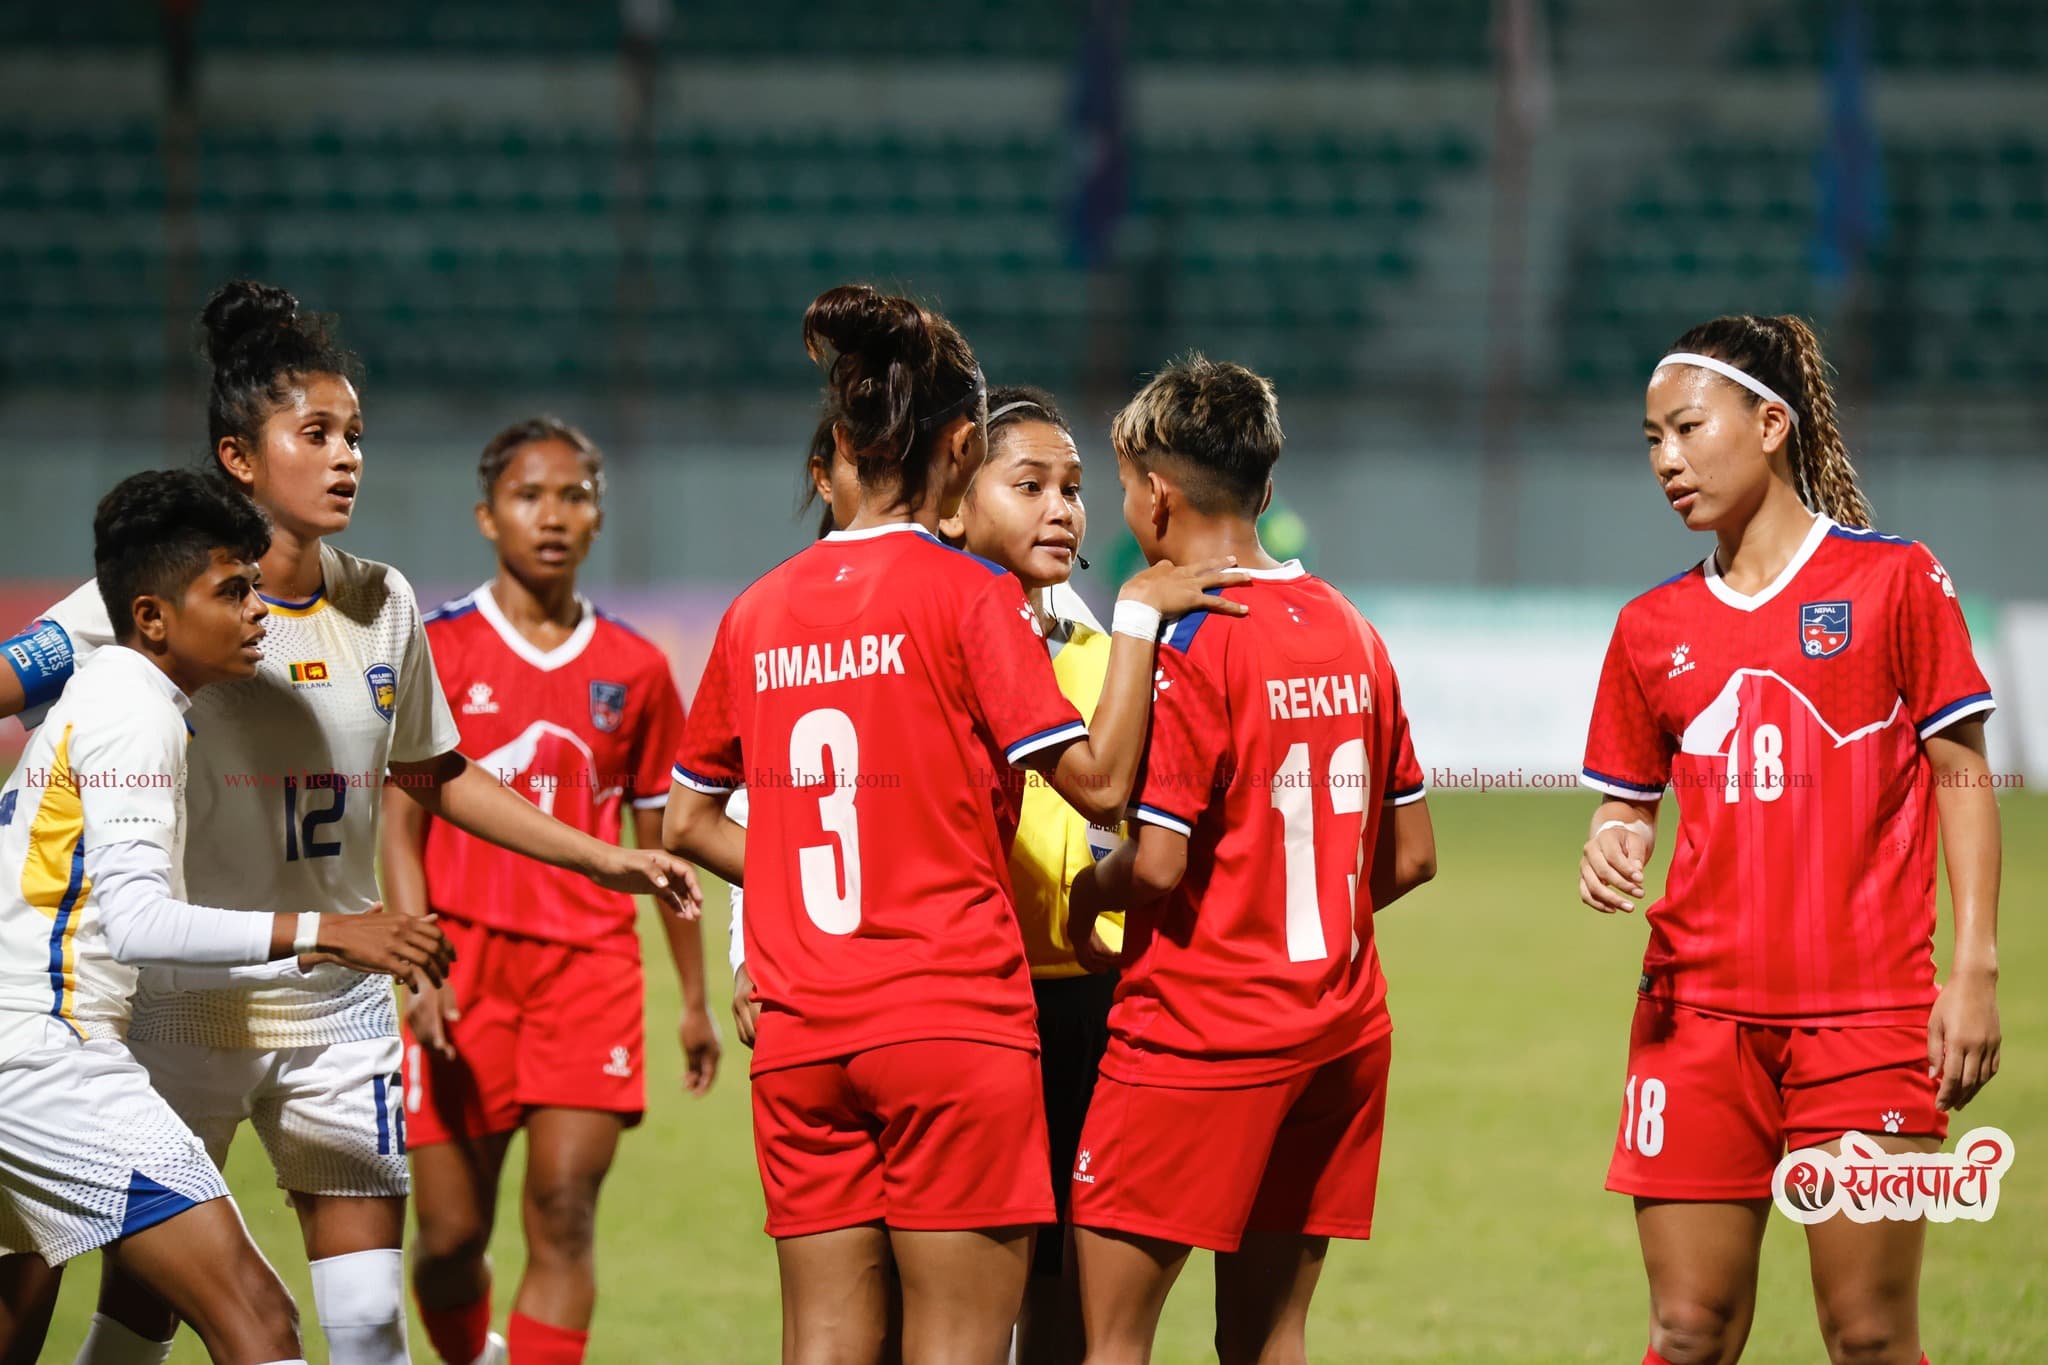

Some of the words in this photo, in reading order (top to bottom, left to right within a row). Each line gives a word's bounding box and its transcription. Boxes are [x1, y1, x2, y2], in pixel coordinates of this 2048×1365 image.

[12, 647, 28, 666] FIFA
[31, 650, 53, 678] World
[32, 631, 65, 671] UNITES
[43, 625, 73, 667] FOOTBALL
[306, 681, 334, 690] LANKA
[1668, 661, 1696, 681] KELME
[1265, 673, 1373, 721] REKHA
[1723, 722, 1785, 806] 18
[283, 772, 347, 863] 12
[788, 707, 863, 936] 3
[1270, 738, 1372, 963] 13
[1624, 1074, 1668, 1158] 18
